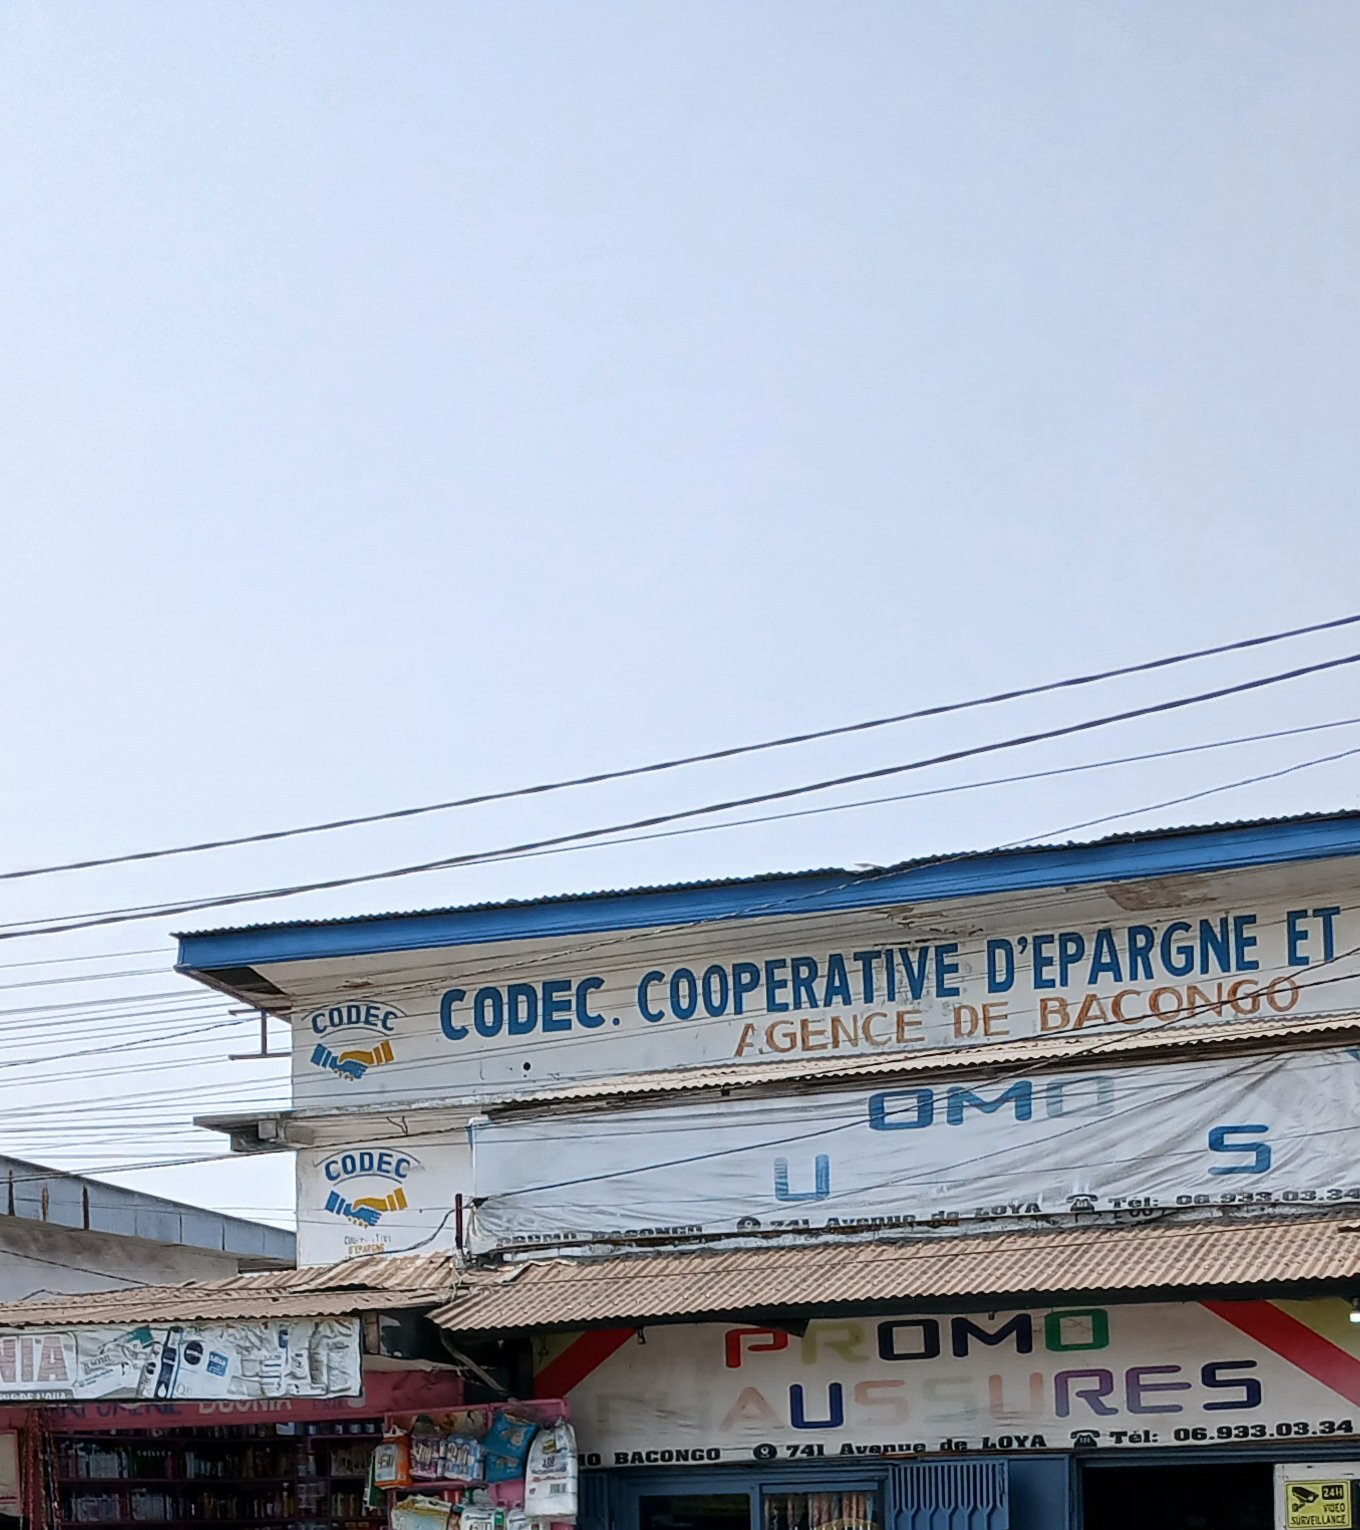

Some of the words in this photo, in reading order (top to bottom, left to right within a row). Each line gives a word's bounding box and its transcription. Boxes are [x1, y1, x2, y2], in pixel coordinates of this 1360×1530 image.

[439, 975, 621, 1042] CODEC.
[637, 942, 961, 1023] COOPERATIVE
[987, 913, 1260, 995] D'EPARGNE
[1286, 905, 1341, 963] ET
[310, 1002, 398, 1035] CODEC
[735, 1008, 924, 1058] AGENCE
[953, 1000, 1011, 1039] DE
[1040, 975, 1302, 1033] BACONGO
[324, 1151, 411, 1182] CODEC
[1207, 1123, 1272, 1176] S
[724, 1308, 1110, 1370] PROMO
[614, 1447, 722, 1466] BACONGO
[786, 1443, 825, 1459] 741
[839, 1442, 927, 1456] Avenue
[940, 1437, 968, 1453] de
[981, 1432, 1047, 1449] LOYA
[1109, 1428, 1159, 1445] Tél:
[1173, 1419, 1354, 1443] 06.933.03.34
[1322, 1487, 1343, 1499] 24H
[1322, 1503, 1346, 1513] VIDEO
[1290, 1515, 1346, 1526] SURVEILLANCE
